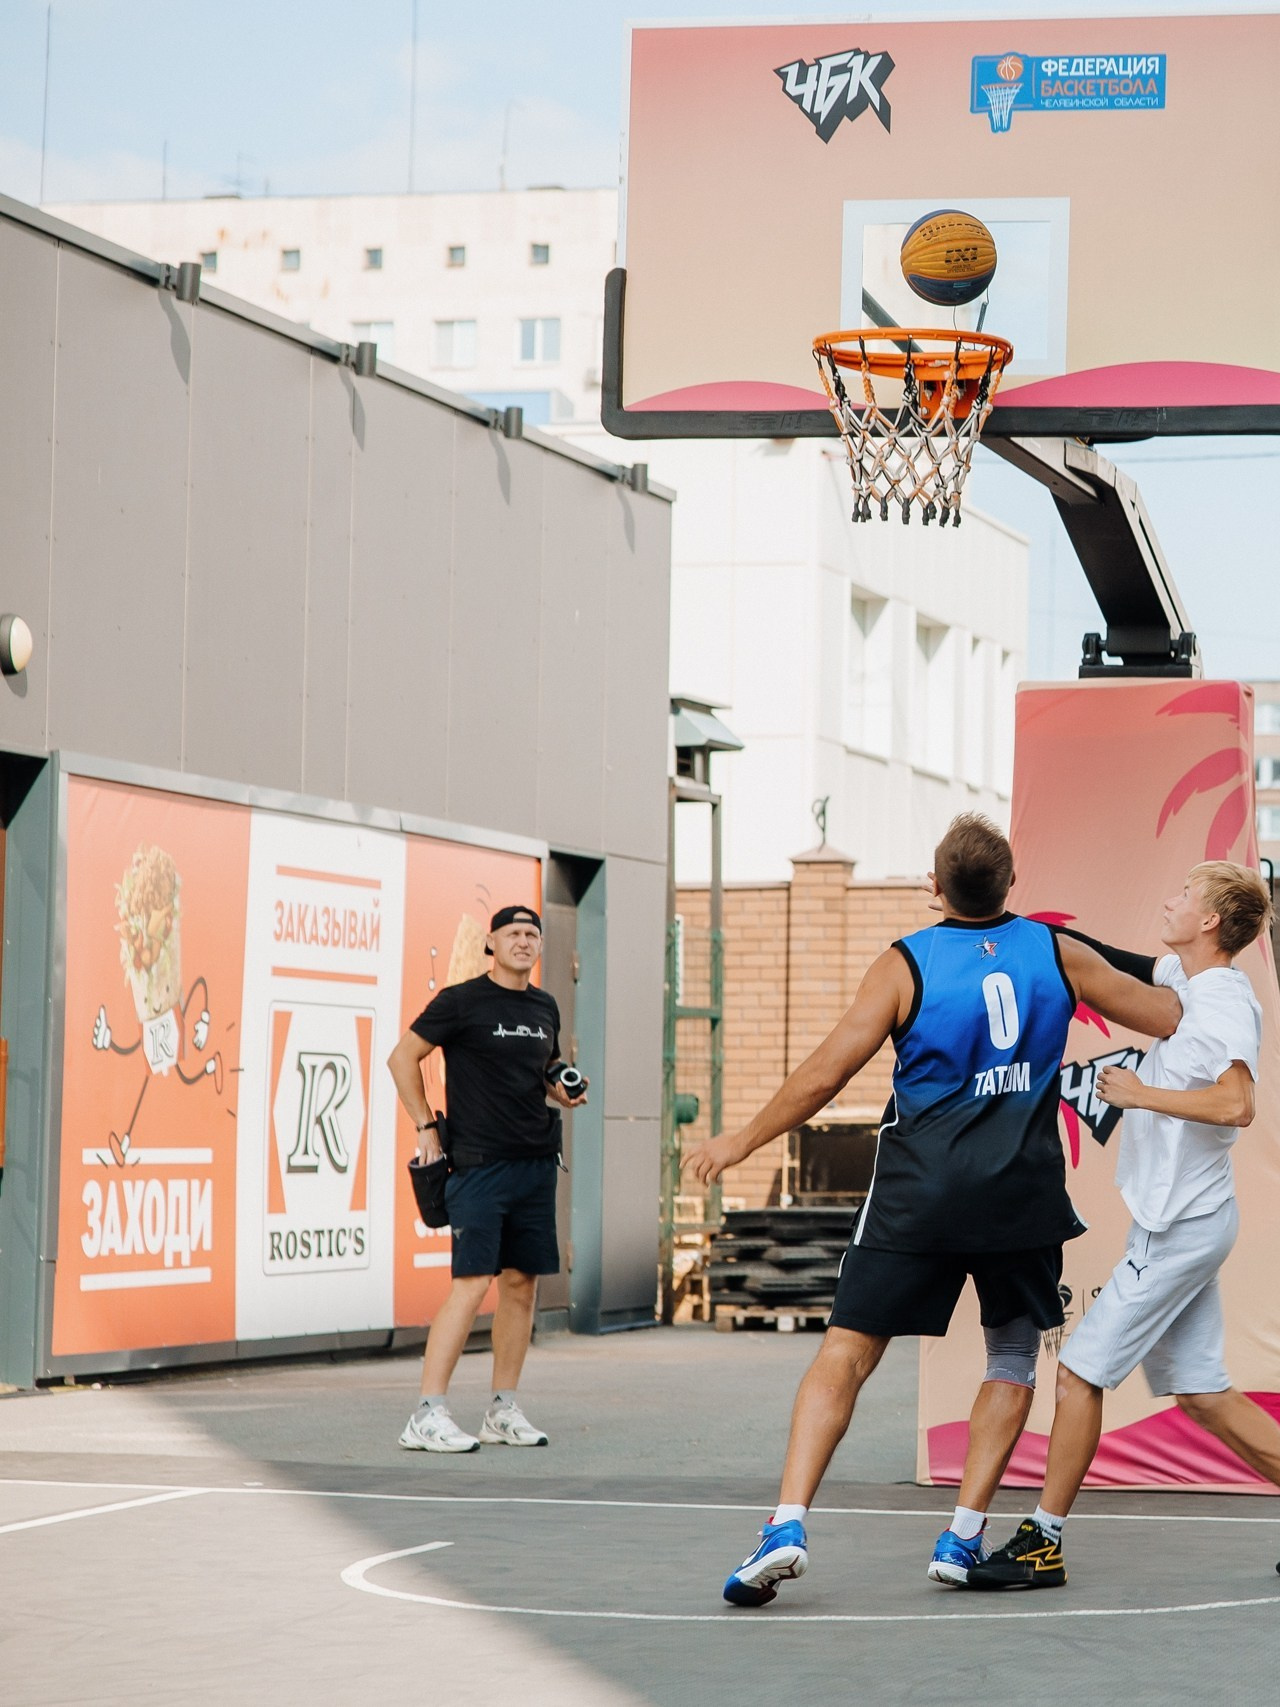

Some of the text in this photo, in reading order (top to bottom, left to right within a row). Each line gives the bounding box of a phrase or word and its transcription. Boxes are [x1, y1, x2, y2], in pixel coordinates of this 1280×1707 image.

[778, 49, 885, 127] ЧБК
[1041, 56, 1160, 78] ФЕДЕРАЦИЯ
[1041, 78, 1158, 97] БАСКЕТБОЛА
[1040, 96, 1159, 108] ЧЕЛЯБИНСКОЙ ОБЛАСТИ
[273, 897, 382, 953] ЗАКАЗЫВАЙ
[982, 972, 1020, 1050] 0
[975, 1062, 1031, 1096] TATUM
[286, 1051, 352, 1174] R
[80, 1177, 213, 1268] ЗАХОДИ
[268, 1227, 366, 1262] ROSTIC'S
